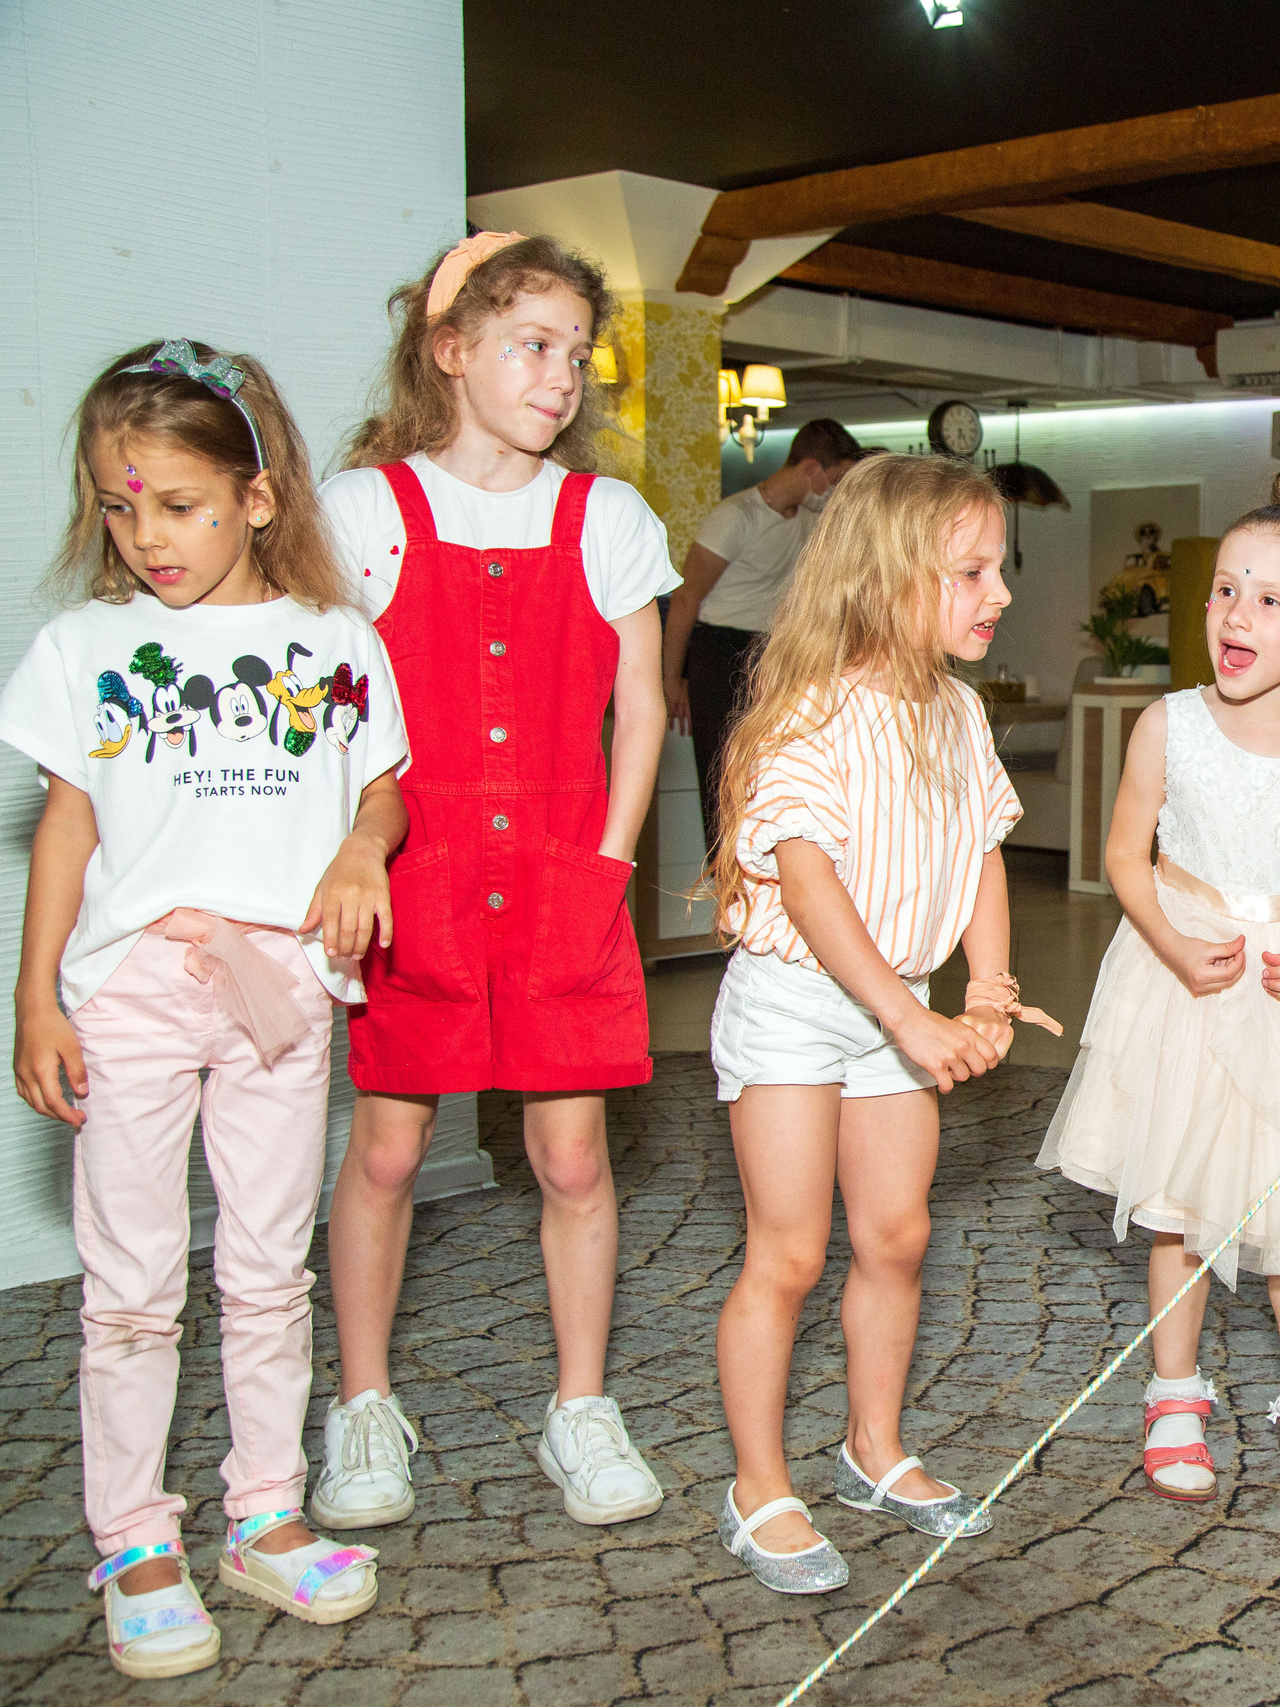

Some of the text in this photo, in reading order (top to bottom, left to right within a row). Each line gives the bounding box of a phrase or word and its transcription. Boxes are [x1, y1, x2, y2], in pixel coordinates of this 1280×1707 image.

[174, 768, 300, 786] HEY! THE FUN
[195, 785, 287, 798] STARTS NOW
